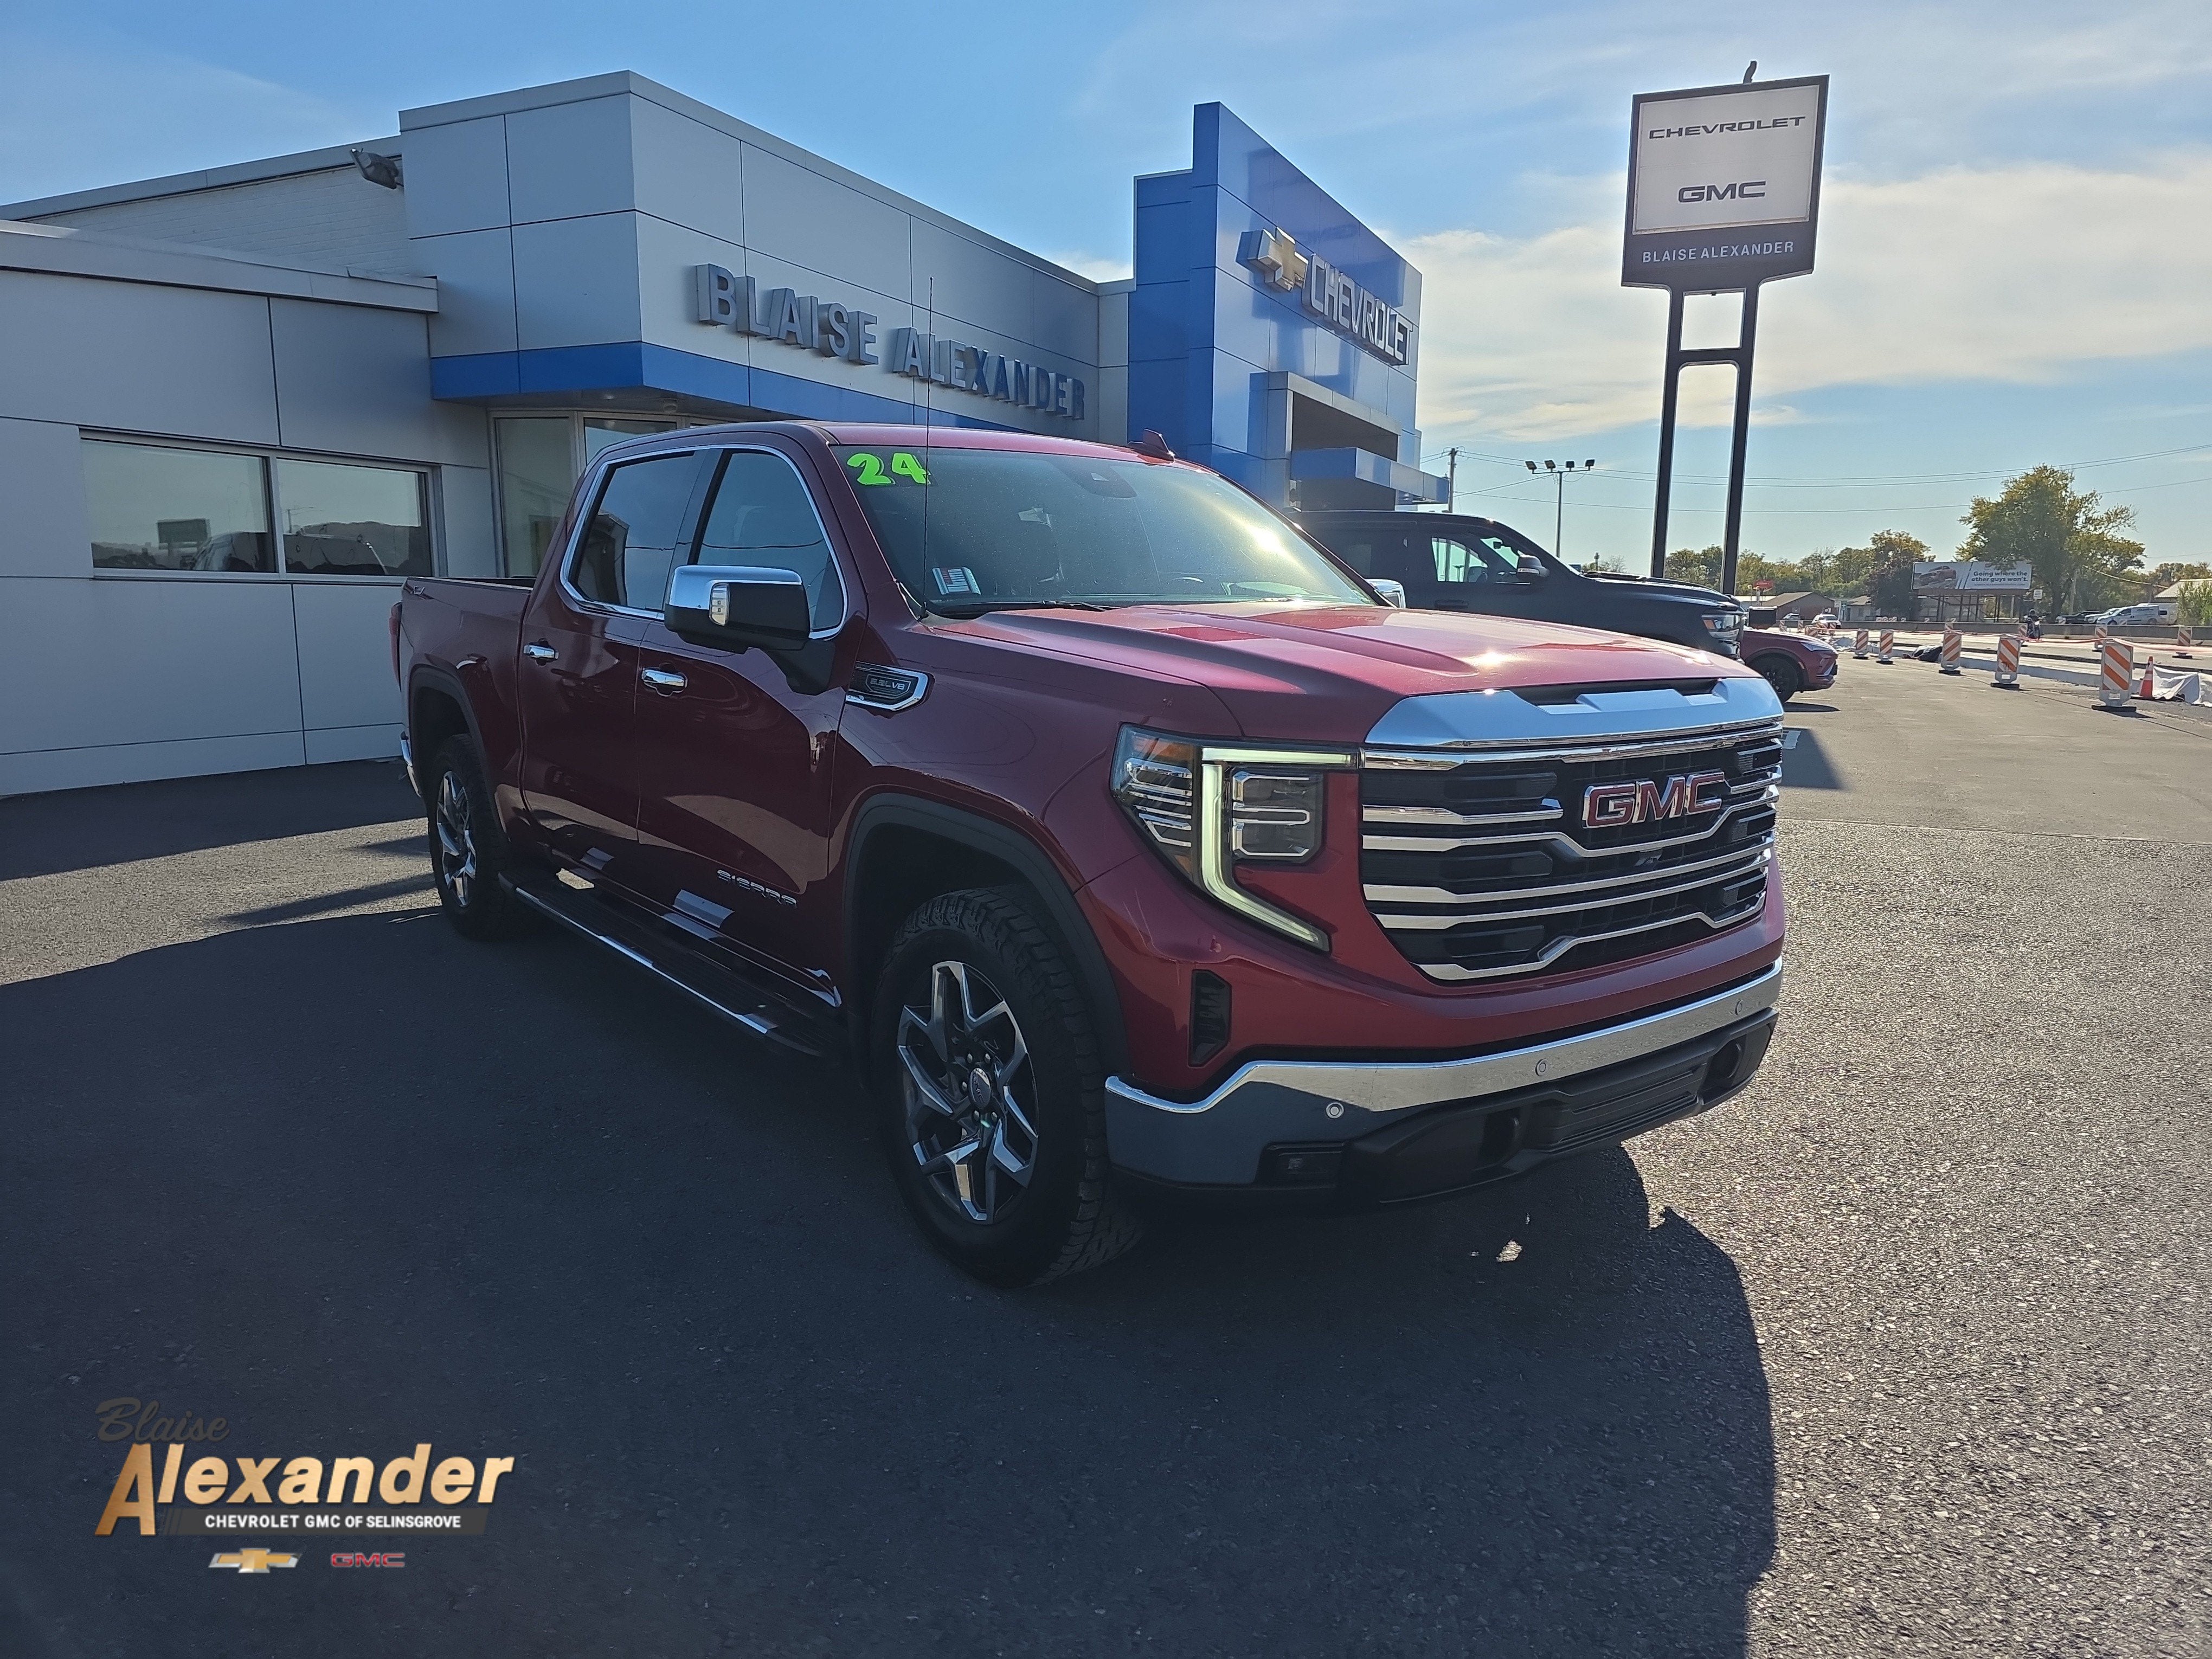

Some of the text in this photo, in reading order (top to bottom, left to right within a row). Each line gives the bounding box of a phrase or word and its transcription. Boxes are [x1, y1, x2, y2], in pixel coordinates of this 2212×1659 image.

[1649, 116, 1806, 139] CHEVROLET
[1678, 181, 1767, 203] GMC
[1642, 241, 1794, 263] BLAISE ALEXANDER
[1308, 254, 1413, 366] CHEVROLET
[698, 263, 1084, 419] BLAISE ALEXANDER
[847, 452, 931, 486] 24
[892, 682, 905, 690] V8
[1583, 771, 1725, 828] GMC
[717, 869, 798, 908] SIERRA
